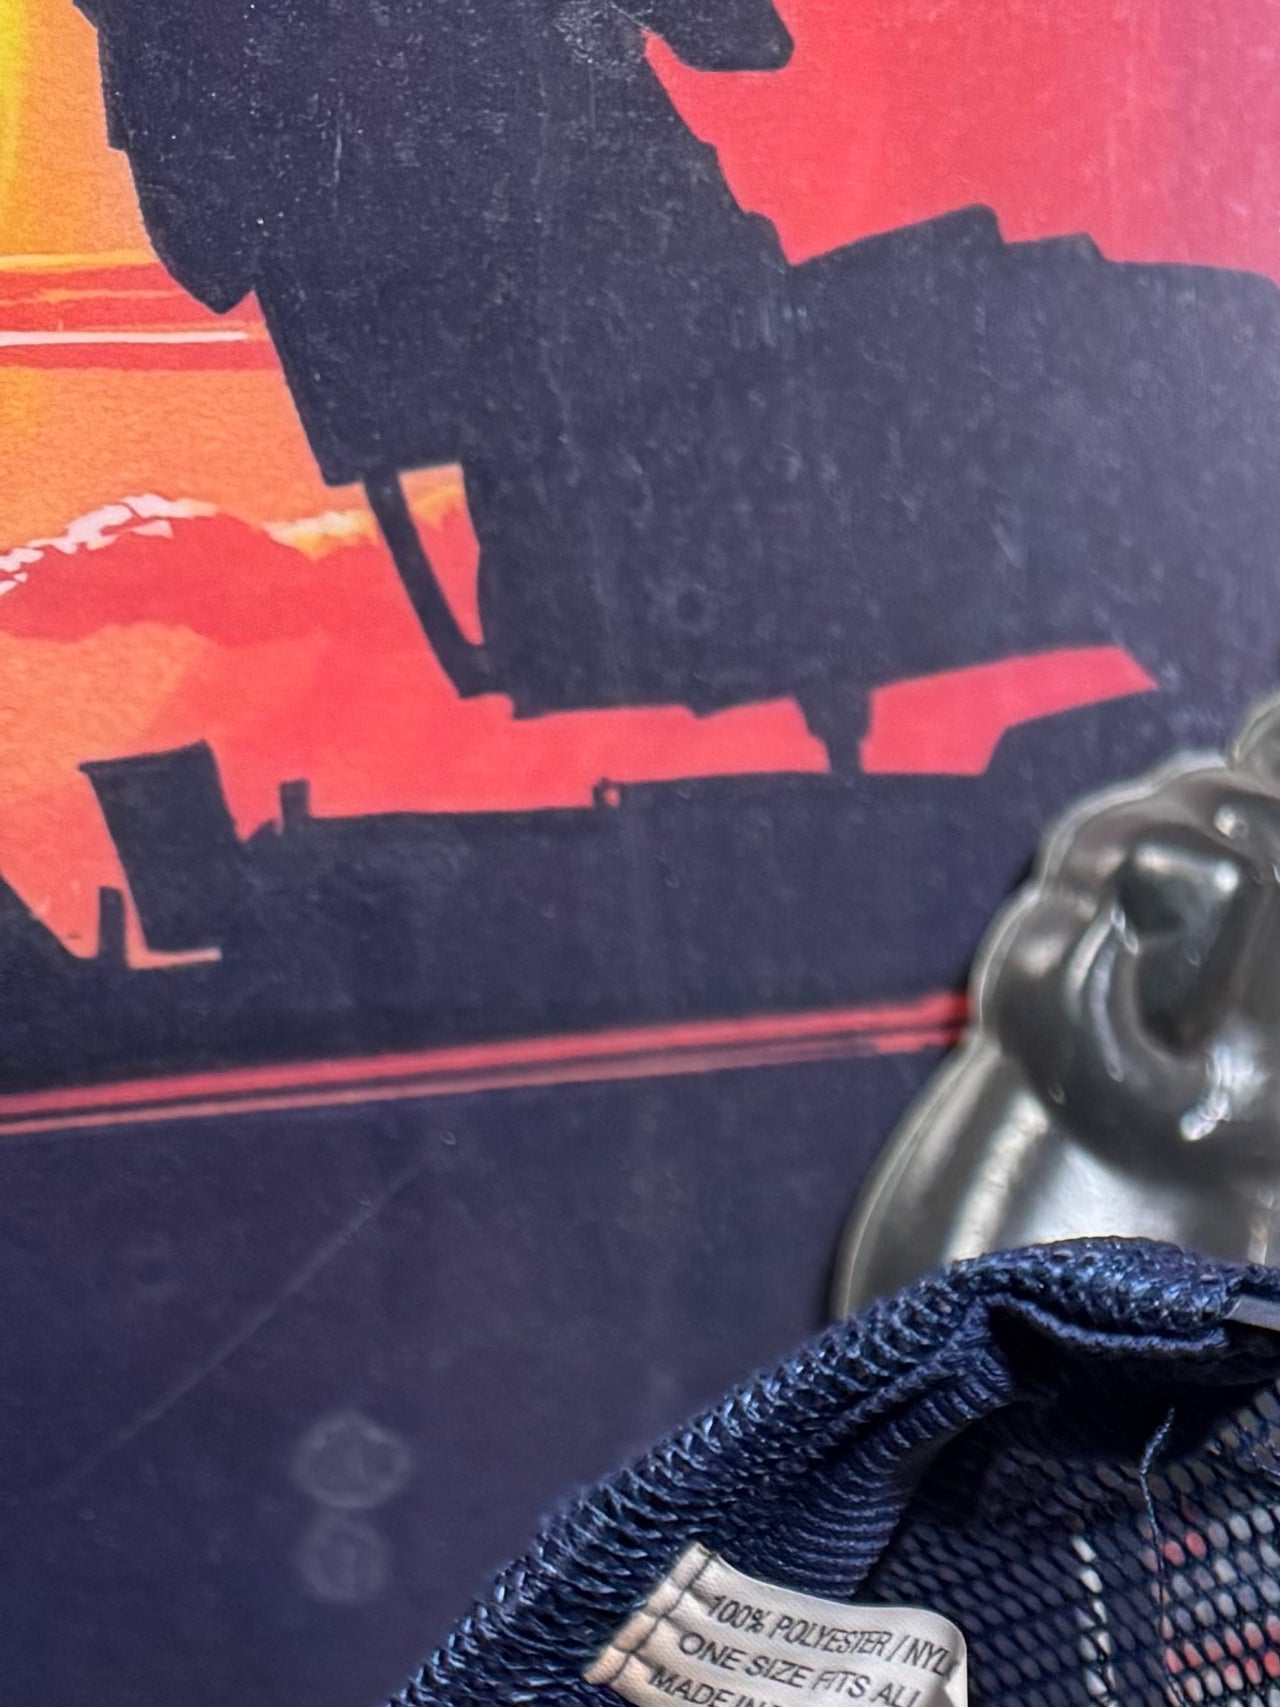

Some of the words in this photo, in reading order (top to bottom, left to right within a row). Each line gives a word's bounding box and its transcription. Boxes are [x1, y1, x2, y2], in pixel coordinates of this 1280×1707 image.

[678, 1631, 743, 1673] ONE
[745, 1655, 818, 1689] SIZE
[812, 1670, 872, 1699] FITS
[707, 1597, 771, 1635] 100%
[773, 1616, 894, 1658] POLYESTER
[903, 1638, 958, 1680] NYL
